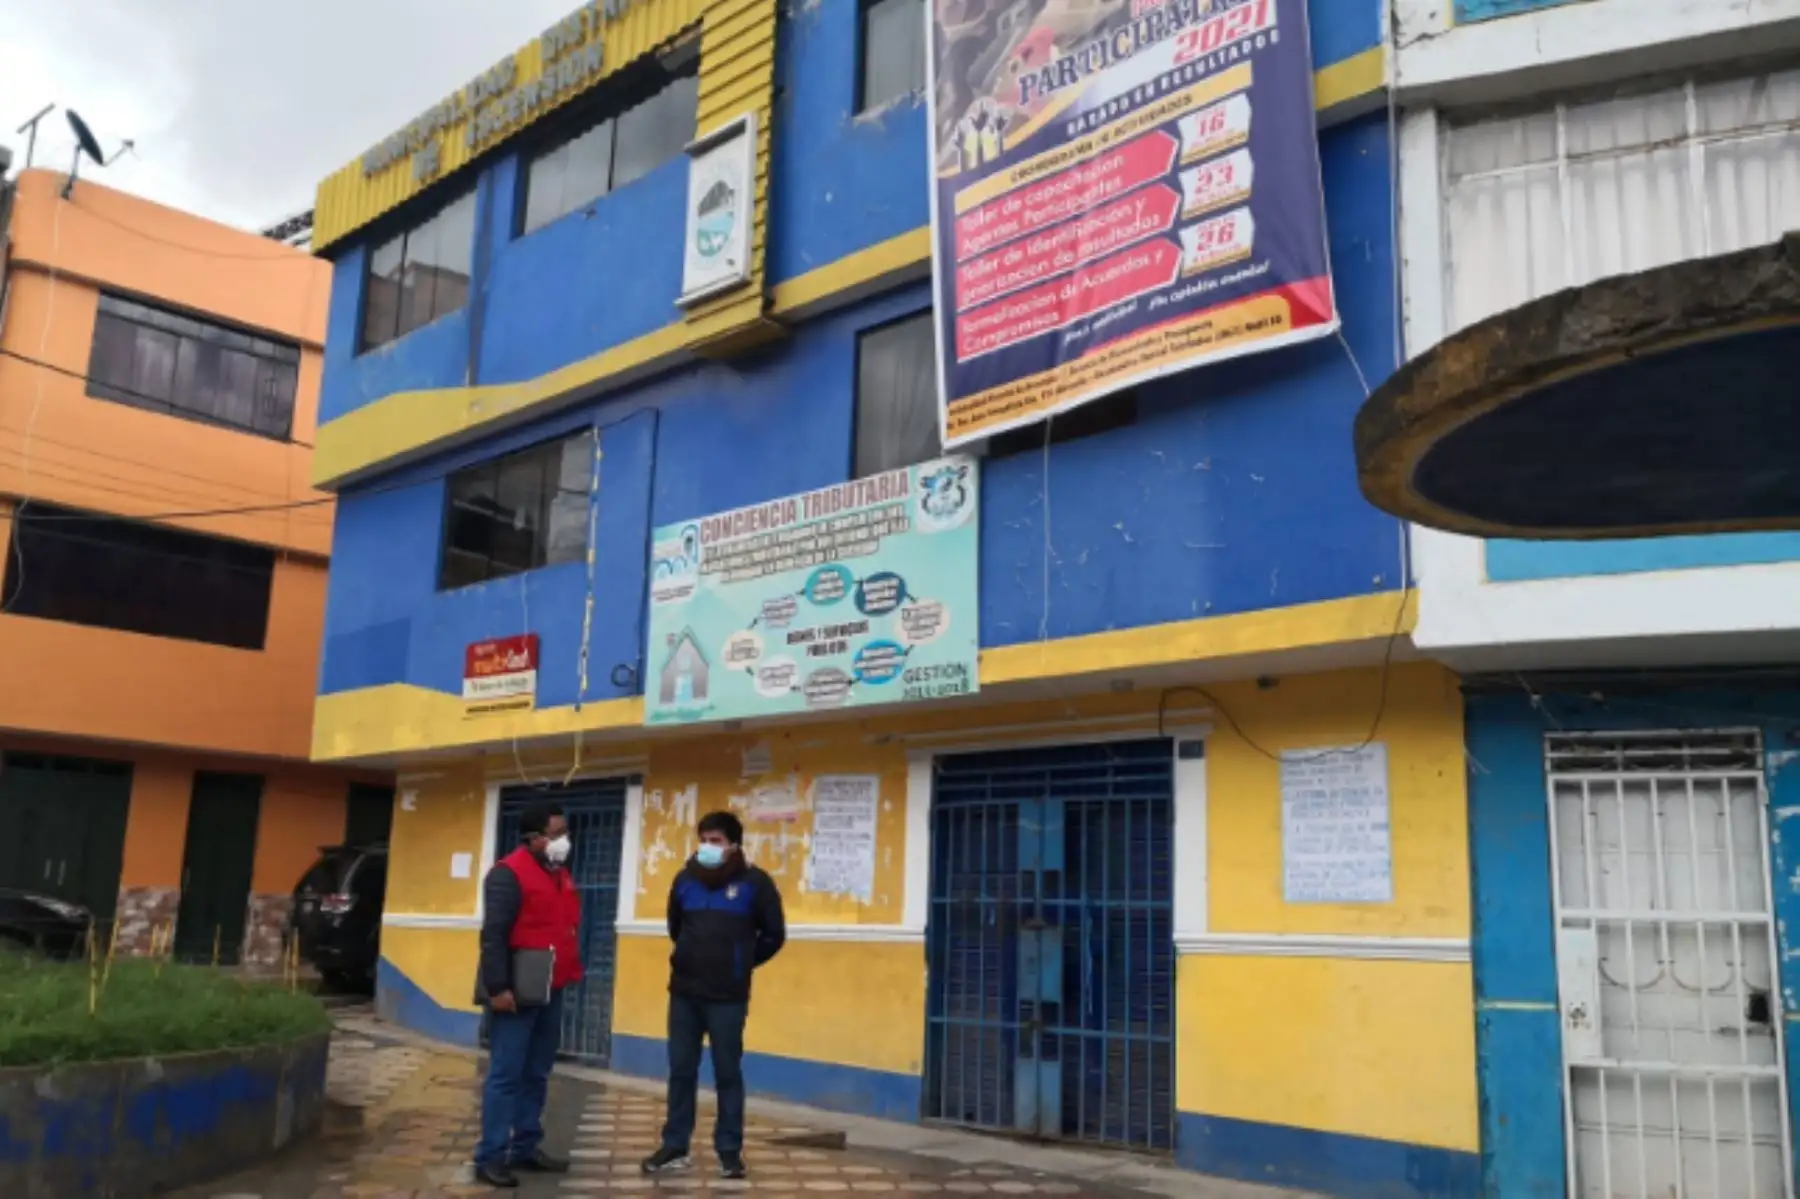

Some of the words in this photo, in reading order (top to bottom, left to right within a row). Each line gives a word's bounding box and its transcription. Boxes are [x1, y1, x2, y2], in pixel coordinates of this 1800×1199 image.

[1173, 0, 1269, 64] 2021
[1161, 28, 1280, 93] RESULTADOS
[1198, 109, 1226, 137] 16
[1195, 163, 1234, 194] 23
[1196, 220, 1235, 252] 26
[700, 498, 797, 545] CONCIENCIA
[801, 469, 909, 520] TRIBUTARIA
[903, 661, 968, 685] GESTION
